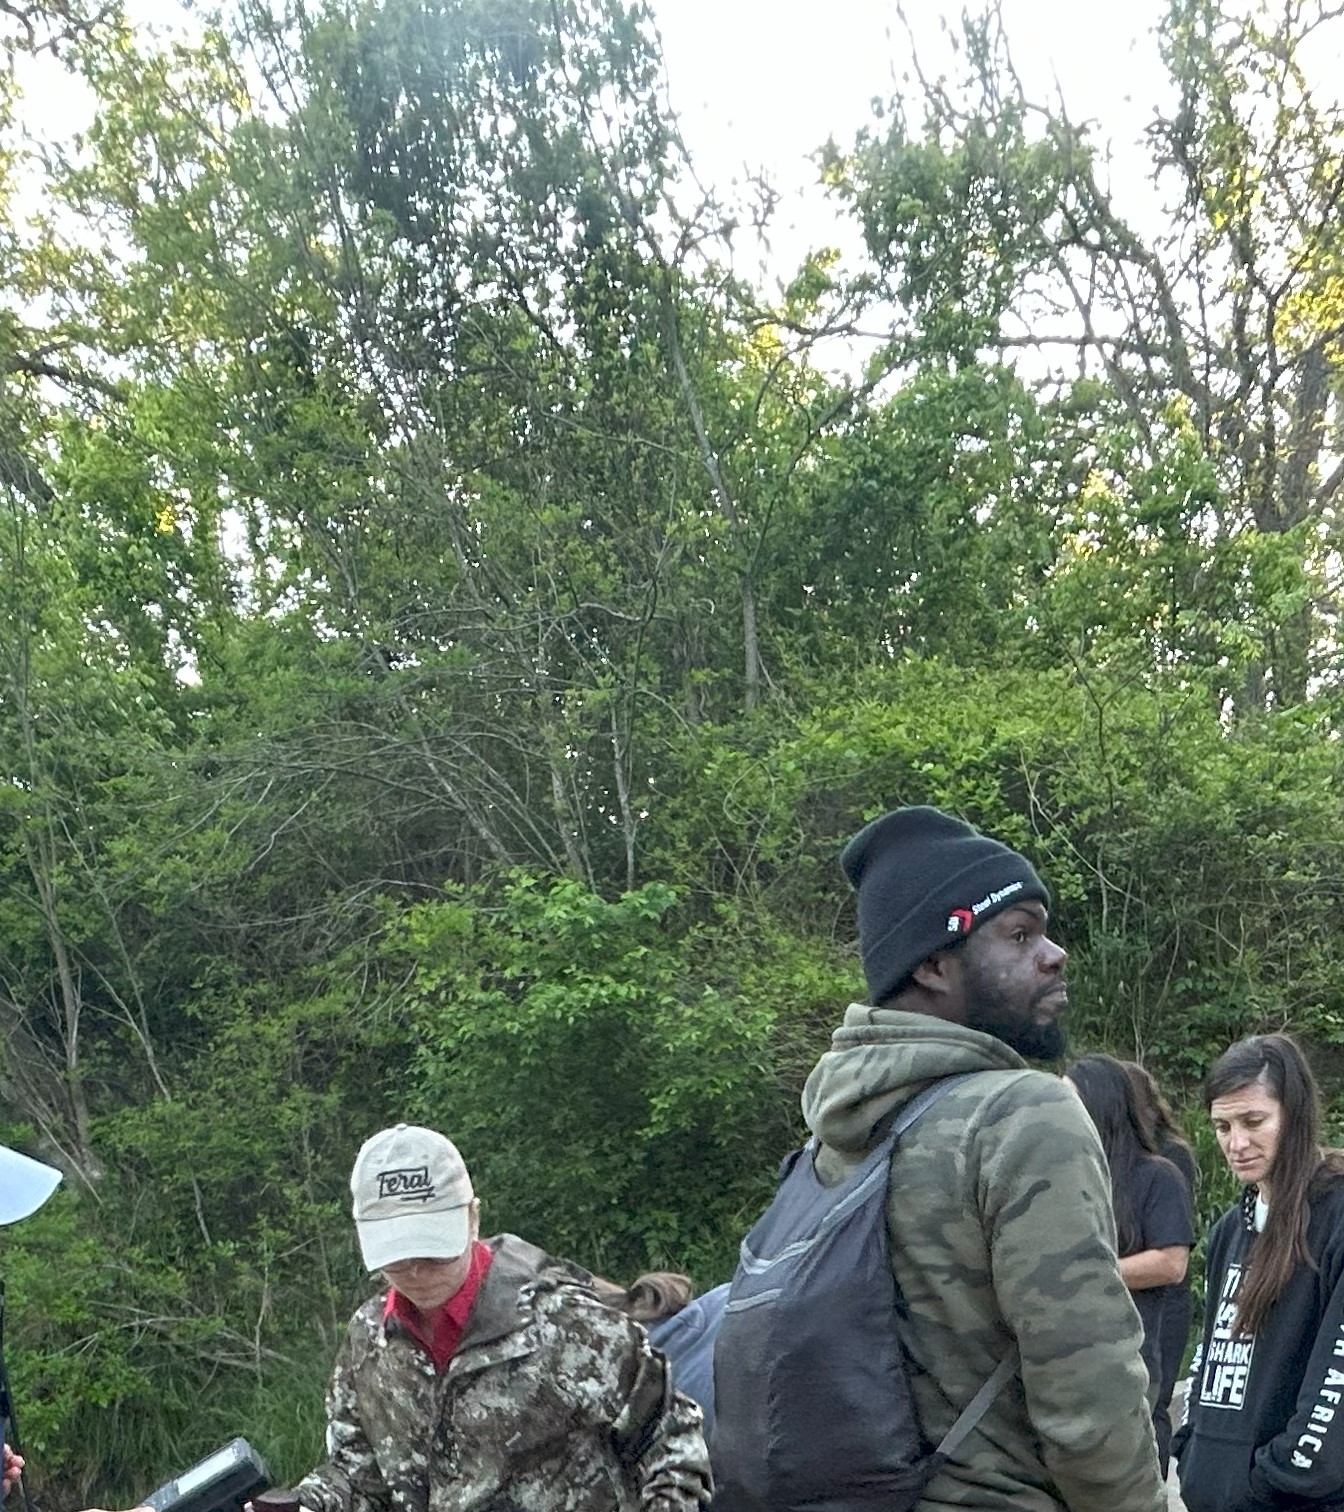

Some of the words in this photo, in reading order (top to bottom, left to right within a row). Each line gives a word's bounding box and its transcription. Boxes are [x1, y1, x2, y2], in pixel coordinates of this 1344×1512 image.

[376, 1166, 434, 1201] Feral
[1208, 1340, 1252, 1364] SHARK
[1200, 1364, 1248, 1404] LIFE
